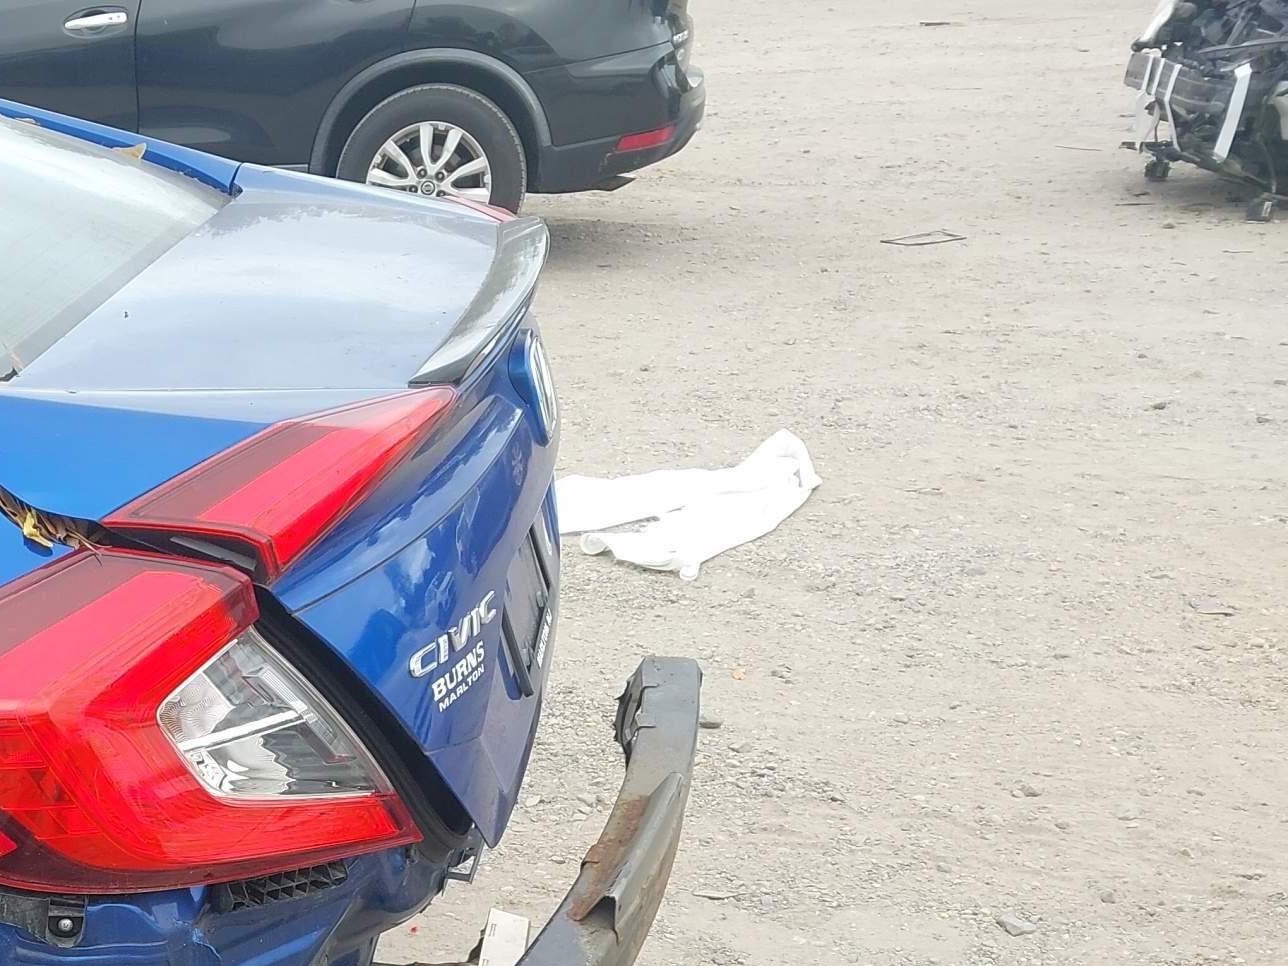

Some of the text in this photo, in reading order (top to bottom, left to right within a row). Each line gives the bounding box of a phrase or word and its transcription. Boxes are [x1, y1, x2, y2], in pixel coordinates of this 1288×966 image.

[409, 590, 497, 678] CIVIC
[431, 640, 485, 702] BURNS
[438, 664, 485, 713] MARLTON
